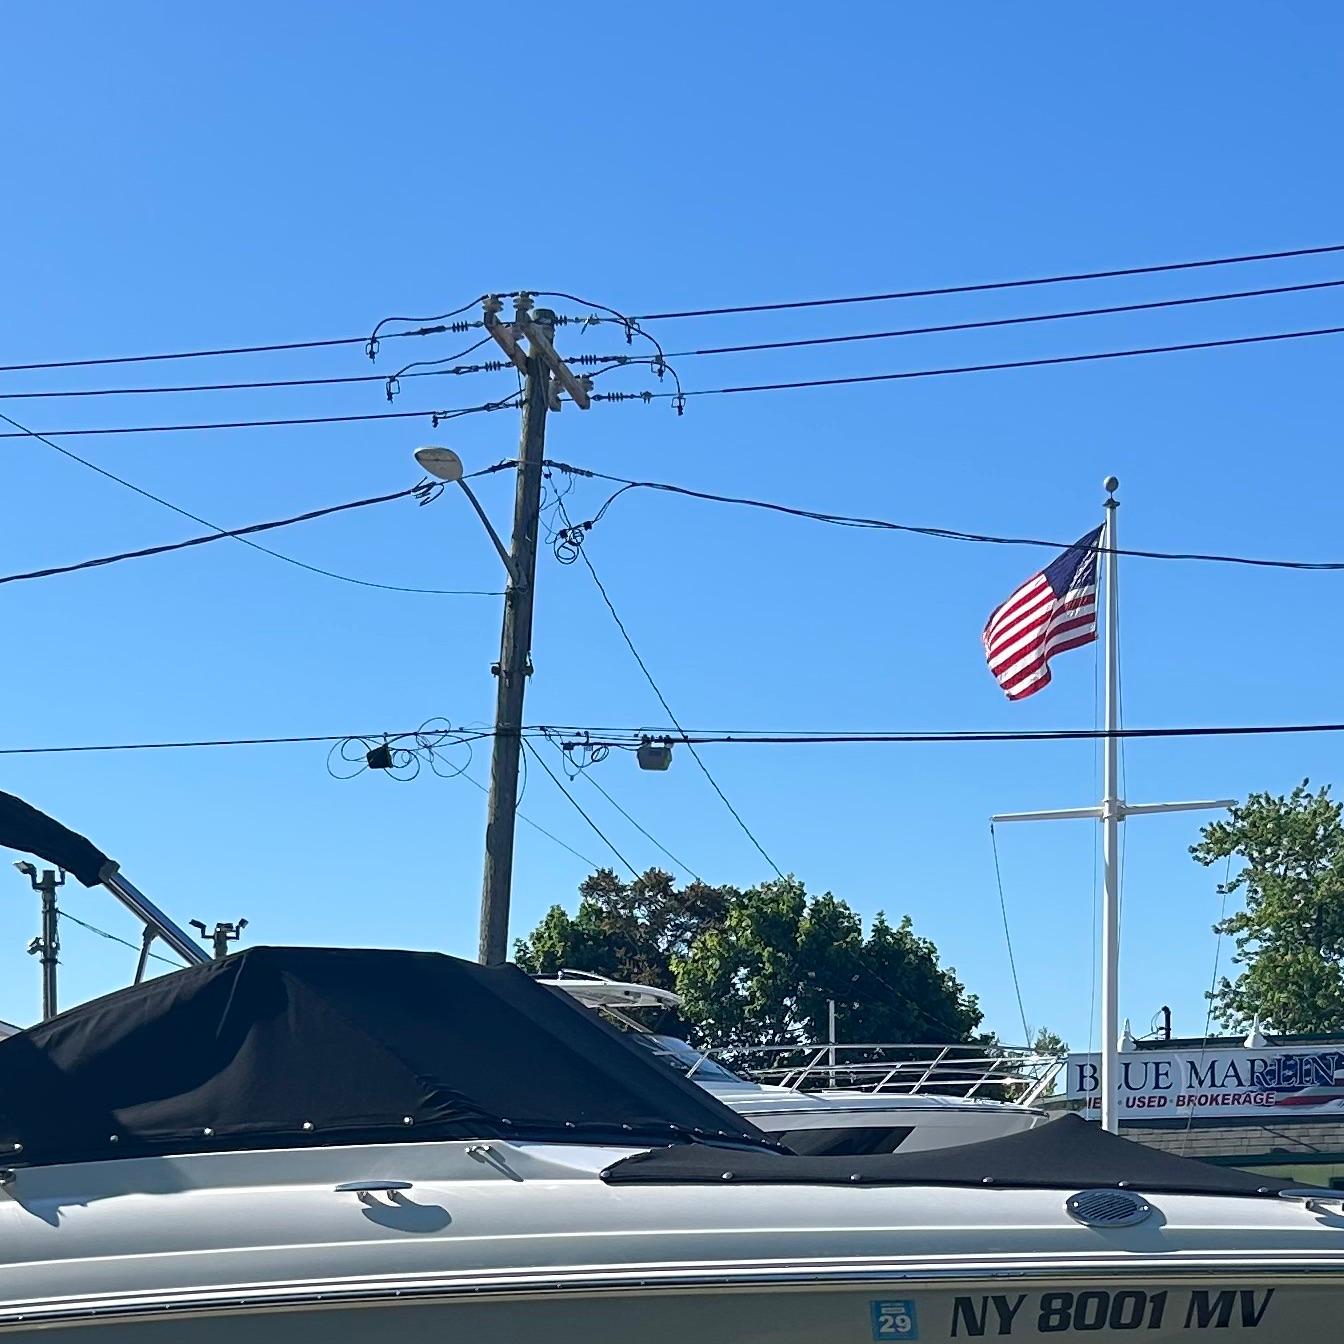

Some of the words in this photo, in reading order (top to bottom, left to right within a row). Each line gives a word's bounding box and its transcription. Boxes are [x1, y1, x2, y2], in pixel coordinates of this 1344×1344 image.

[1076, 1061, 1174, 1092] BUE
[1186, 1054, 1338, 1089] MARLIN
[1125, 1095, 1167, 1109] USED
[1176, 1091, 1277, 1107] BROKERAGE
[879, 1314, 911, 1333] 29
[950, 1294, 1028, 1337] NY
[1037, 1290, 1169, 1333] 8001
[1183, 1287, 1276, 1329] MV
